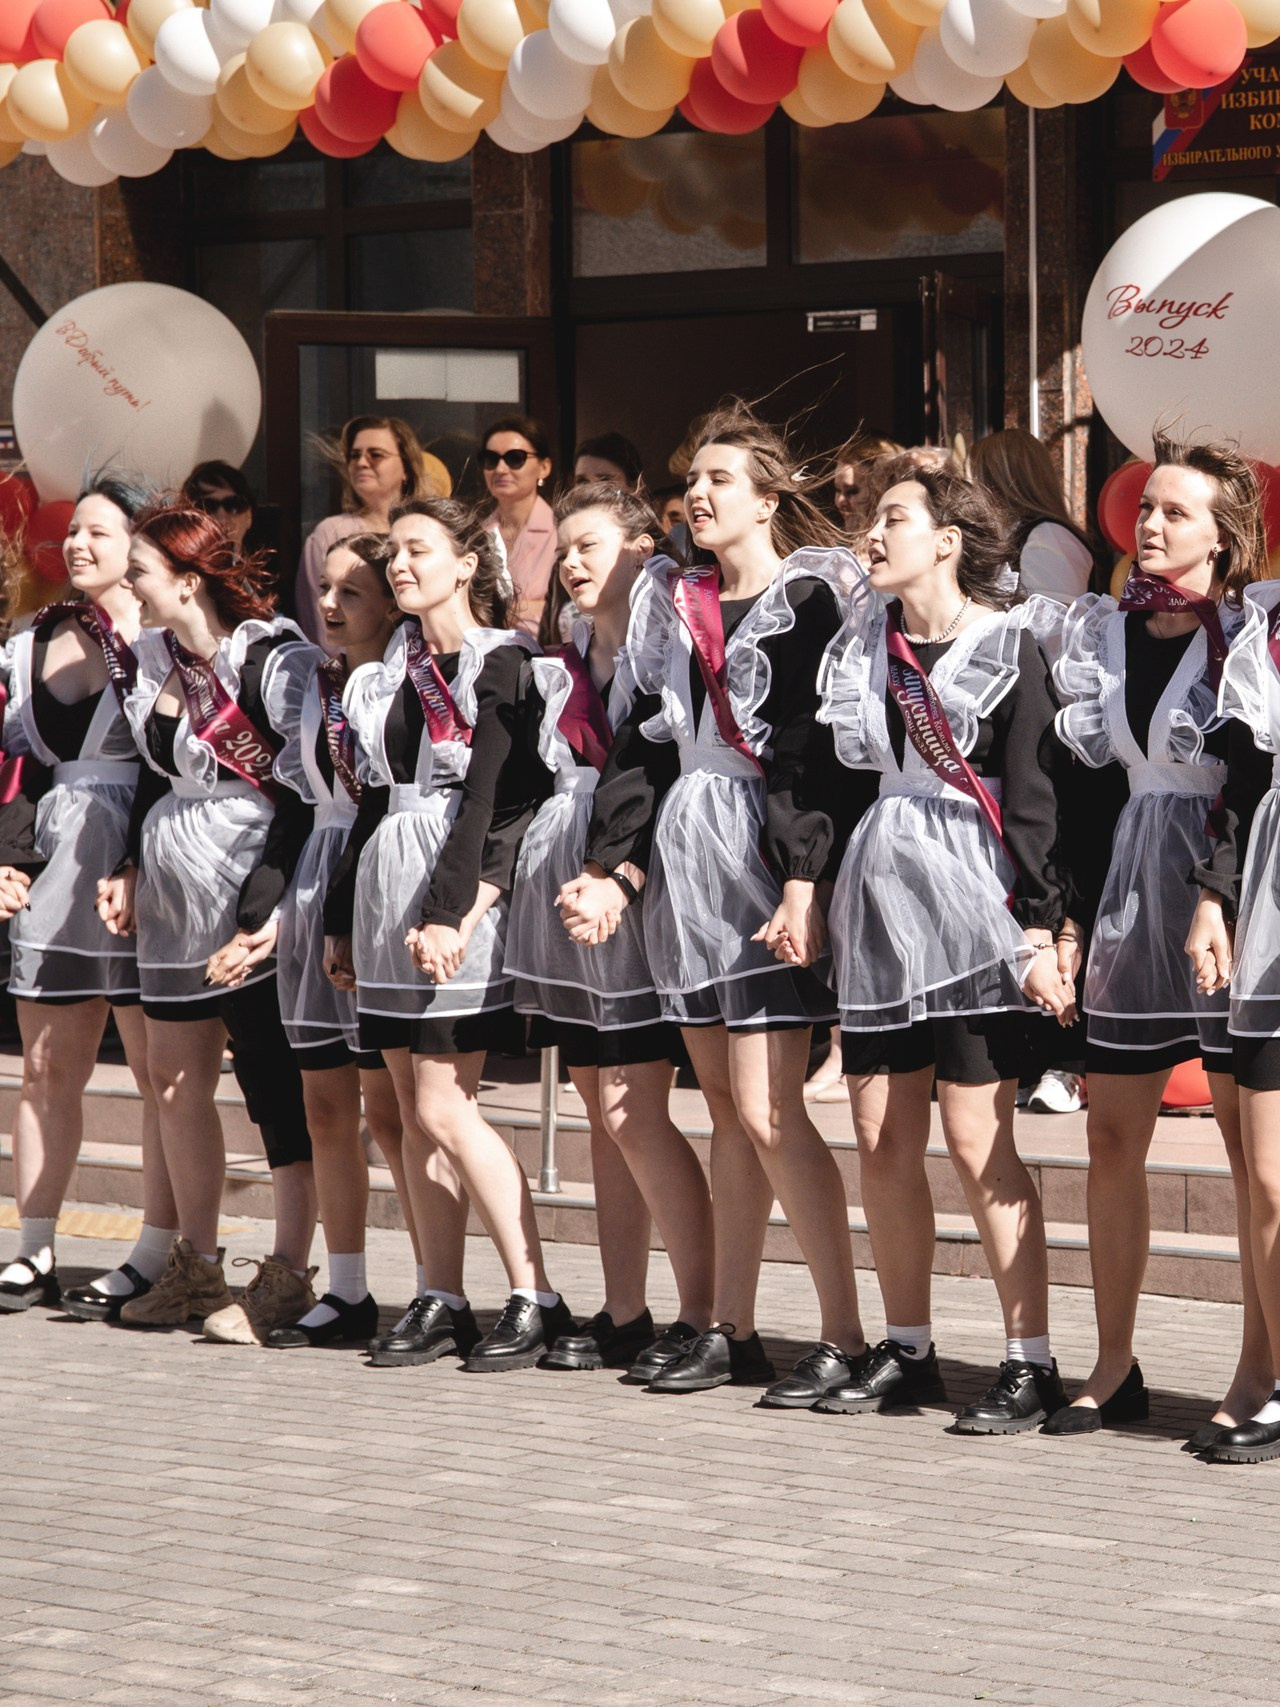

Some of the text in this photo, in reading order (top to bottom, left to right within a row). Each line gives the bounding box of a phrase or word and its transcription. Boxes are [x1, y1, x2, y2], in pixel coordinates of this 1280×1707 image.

[1163, 145, 1272, 167] ИЗБИРАТЕЛЬНОГО
[1106, 284, 1234, 329] Выпуск
[1125, 336, 1210, 359] 2024
[899, 668, 963, 774] ыпускница
[934, 719, 952, 752] Камила
[222, 730, 274, 783] 2024
